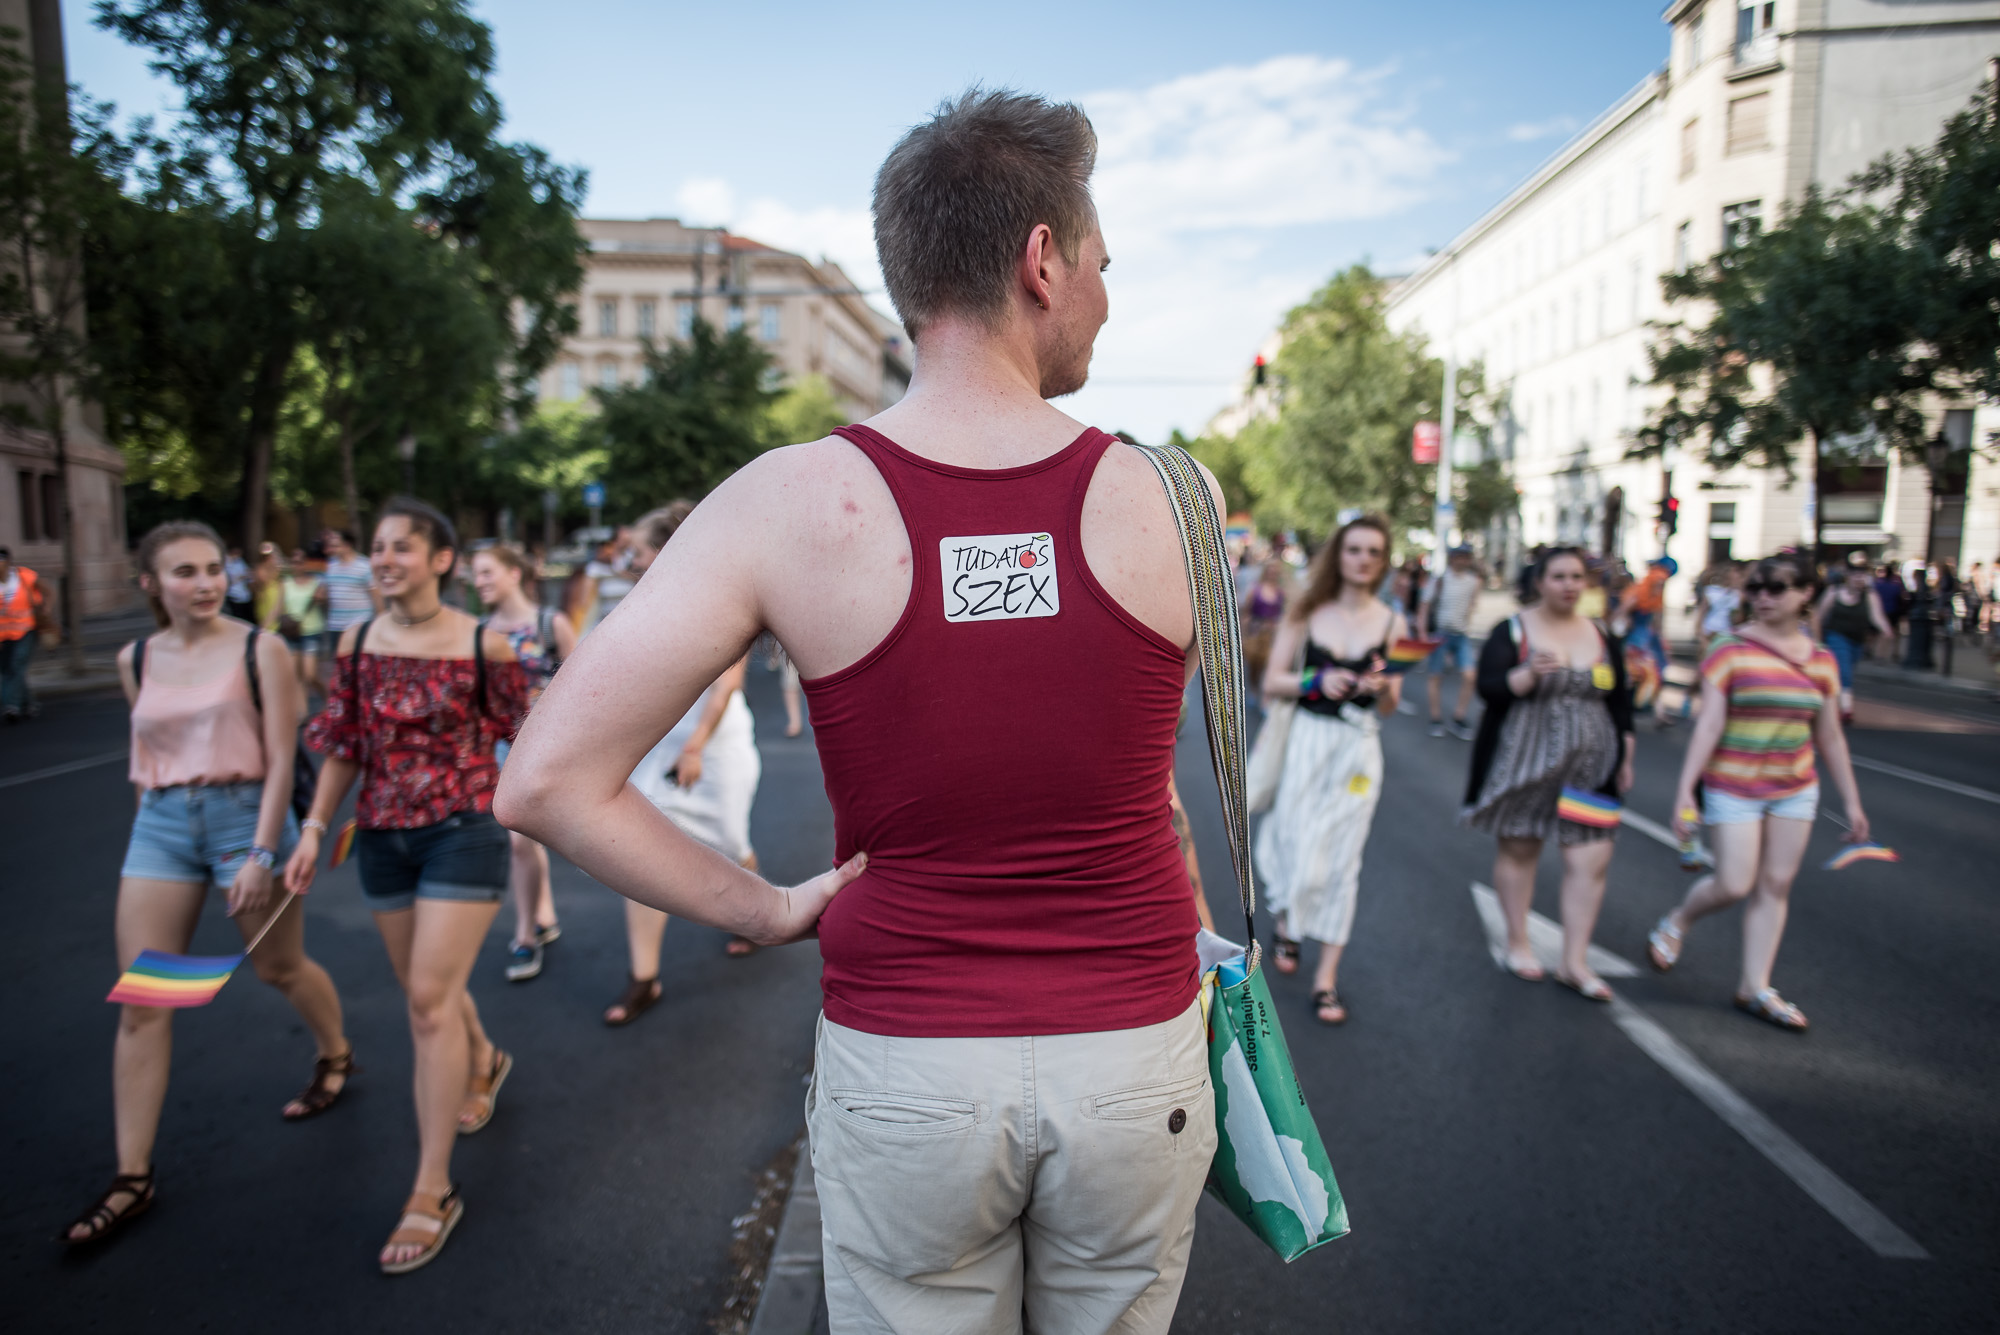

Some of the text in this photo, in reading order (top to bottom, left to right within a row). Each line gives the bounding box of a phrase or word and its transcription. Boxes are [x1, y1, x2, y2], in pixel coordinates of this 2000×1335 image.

[952, 543, 1049, 571] TUDATOS
[947, 573, 1054, 617] SZEX
[1258, 1001, 1271, 1038] 7.700
